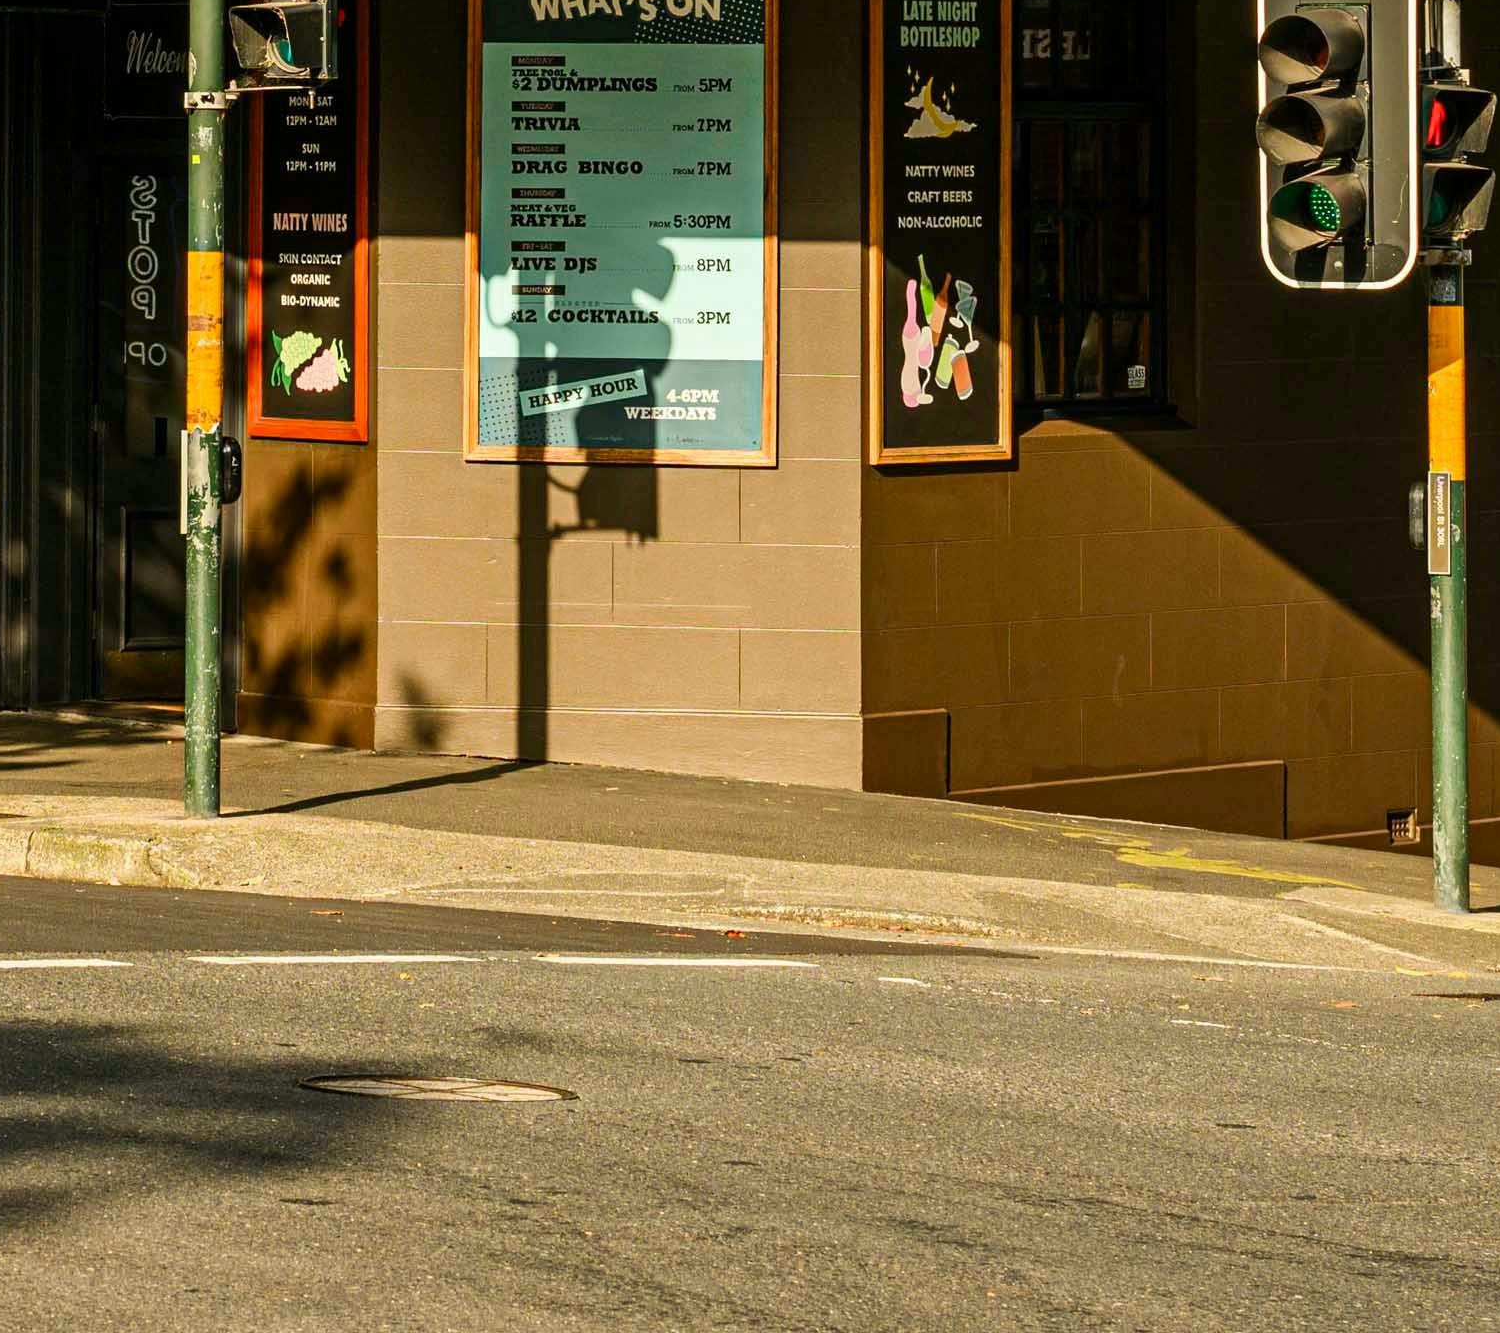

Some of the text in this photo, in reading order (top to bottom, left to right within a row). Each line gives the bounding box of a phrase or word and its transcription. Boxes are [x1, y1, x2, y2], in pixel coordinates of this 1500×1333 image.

[903, 0, 977, 22] LATE NIGHT
[900, 26, 980, 48] BOTTLESHOP
[126, 30, 186, 74] Welcom
[512, 69, 578, 77] FREE POOL &
[512, 78, 532, 91] $2
[537, 78, 657, 92] DUMPLINGS
[699, 79, 731, 92] 5PM
[289, 95, 333, 107] MON SAT
[286, 115, 306, 126] 12PM
[315, 115, 337, 125] 12AM
[512, 118, 731, 132] TRIVIA FROM 7PM
[302, 143, 320, 154] SUN
[285, 161, 306, 171] 12PM
[315, 161, 336, 172] 11PM
[512, 161, 567, 174] DRAG
[578, 161, 643, 174] BINGO
[698, 162, 731, 175] 7PM
[905, 165, 975, 177] NATTY WINES
[907, 191, 972, 203] CRAFT BEERS
[273, 213, 347, 231] NATTY WINES
[511, 214, 586, 227] RAFFLE
[673, 215, 731, 229] 5:30PM
[898, 216, 983, 228] NON-ALCOHOLIC
[279, 253, 342, 265] SKIN CONTACT
[511, 257, 555, 271] LIVE
[564, 257, 597, 274] DJS
[697, 258, 731, 272] 8PM
[291, 274, 331, 285] ORGANIC
[281, 295, 341, 307] BIO-DYNAMIC
[511, 310, 537, 323] $12
[548, 310, 659, 324] COCKTAILS
[697, 311, 731, 324] 3PM
[528, 378, 638, 409] HAPPY HOUR
[666, 389, 719, 403] 4-6PM
[624, 406, 717, 420] WEEKDAYS
